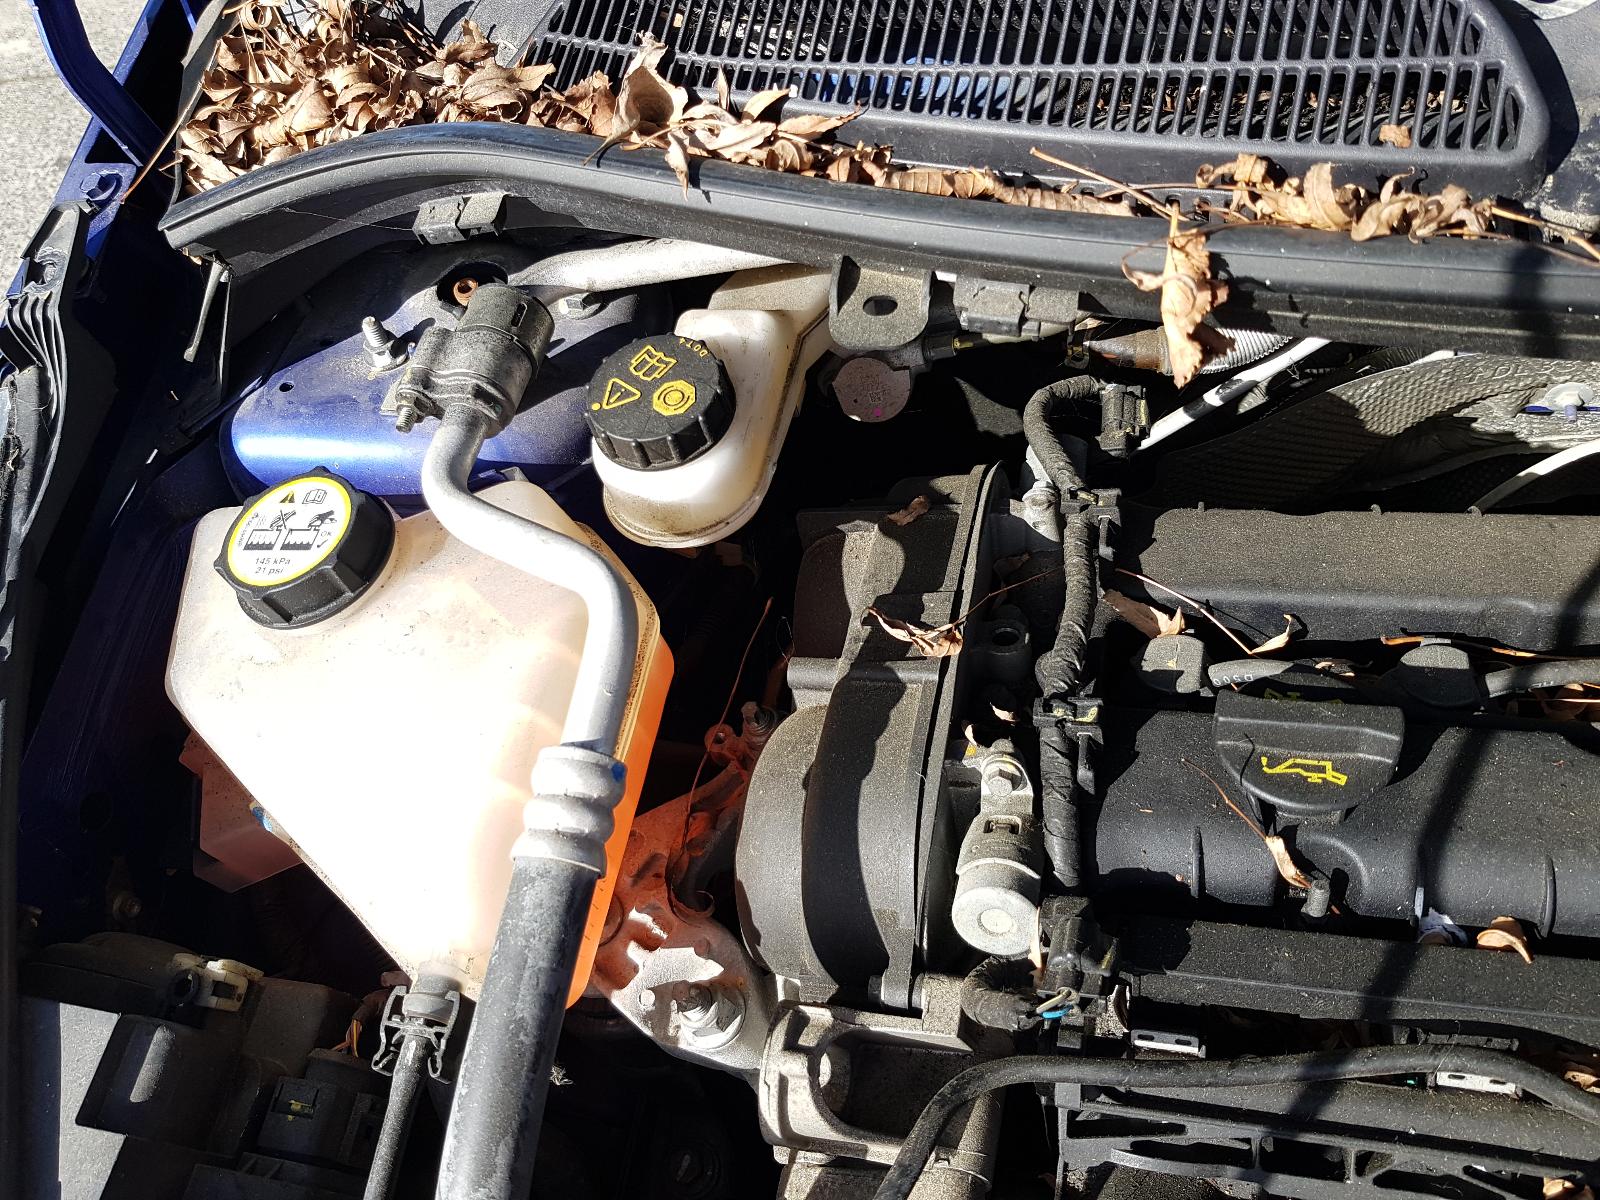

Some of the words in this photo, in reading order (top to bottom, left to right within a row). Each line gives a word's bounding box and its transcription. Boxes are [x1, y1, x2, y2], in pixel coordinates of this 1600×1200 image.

[679, 337, 709, 358] DOT4
[255, 557, 271, 565] 145
[272, 557, 291, 565] kPa
[268, 567, 284, 575] psi
